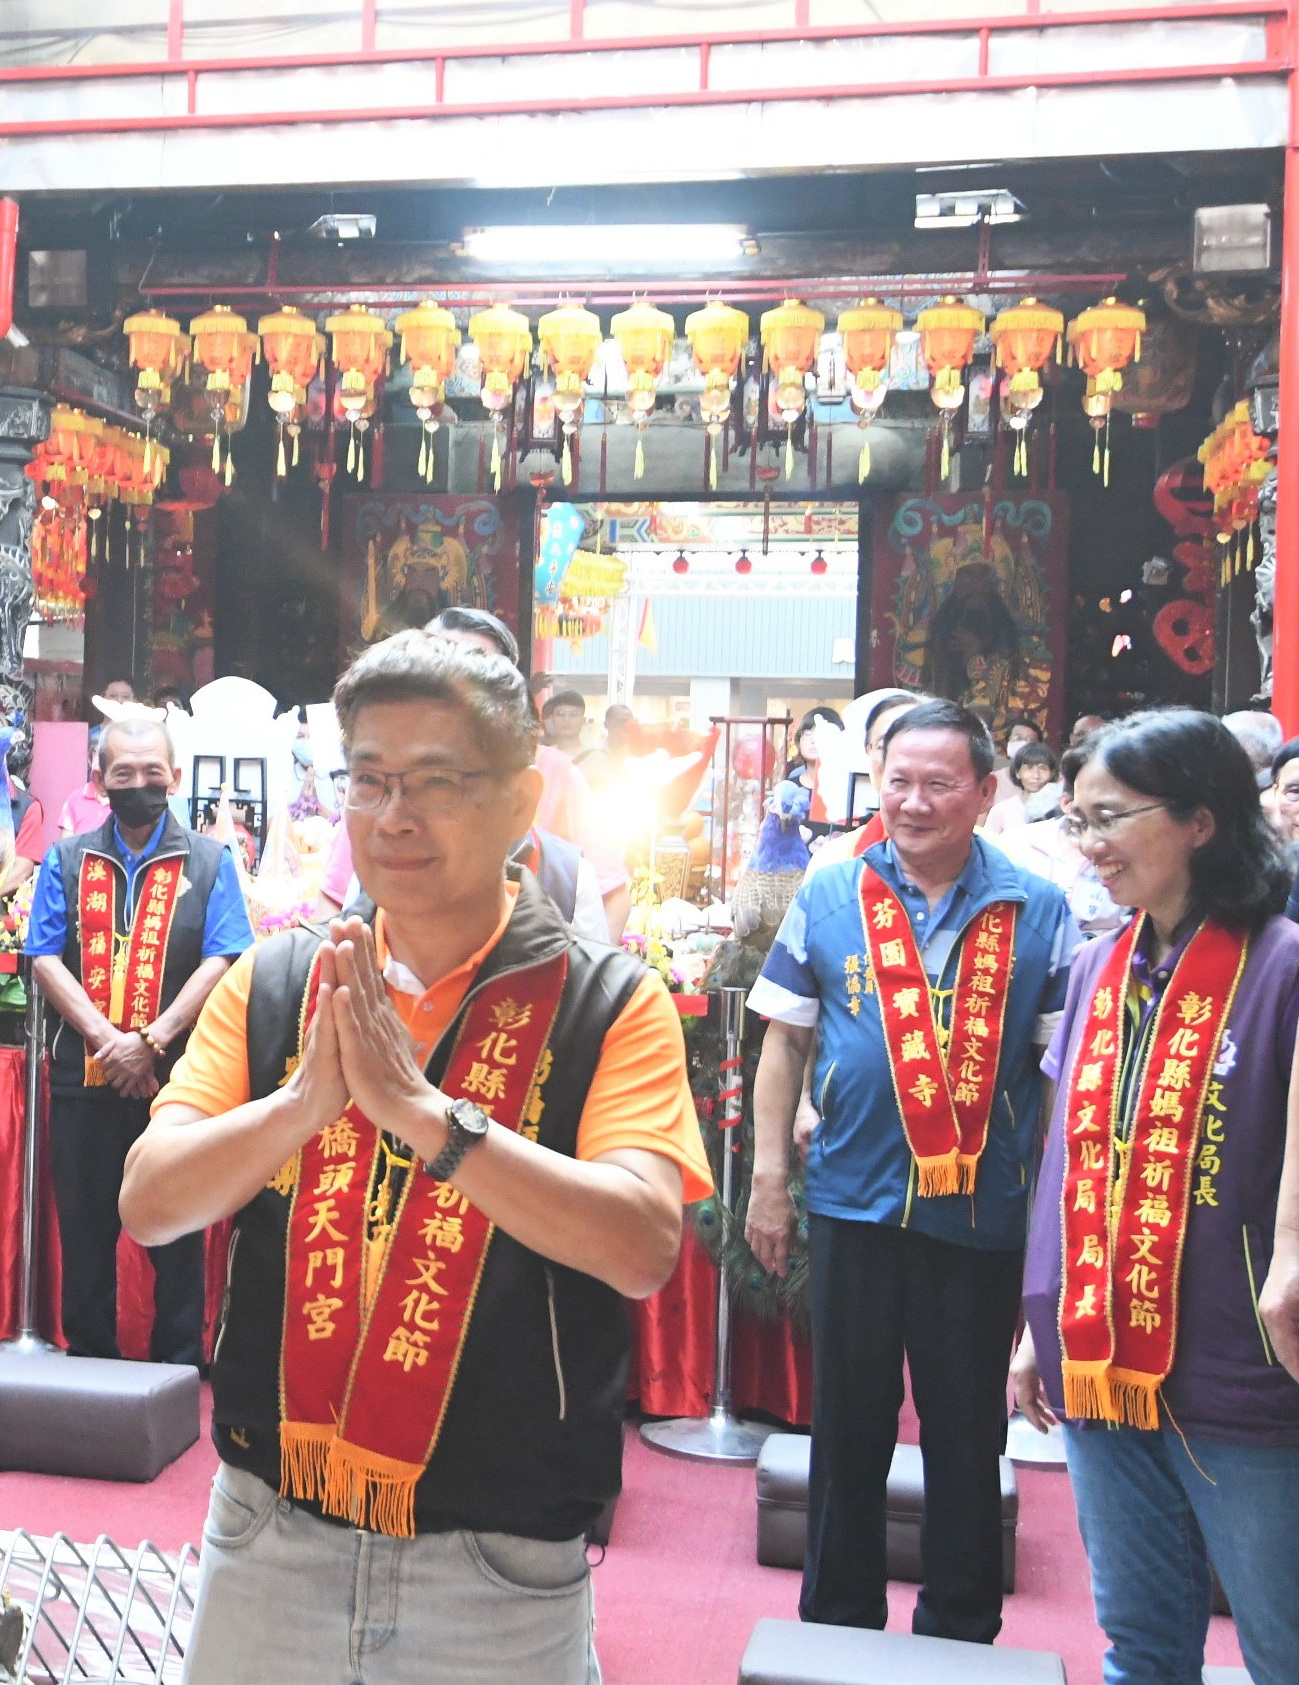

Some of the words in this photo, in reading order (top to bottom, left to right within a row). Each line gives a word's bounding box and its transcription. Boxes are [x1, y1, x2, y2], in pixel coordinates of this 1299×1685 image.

[302, 1098, 361, 1341] 橋頭天門宮
[1125, 990, 1214, 1336] 彰化縣媽祖祈福文化節
